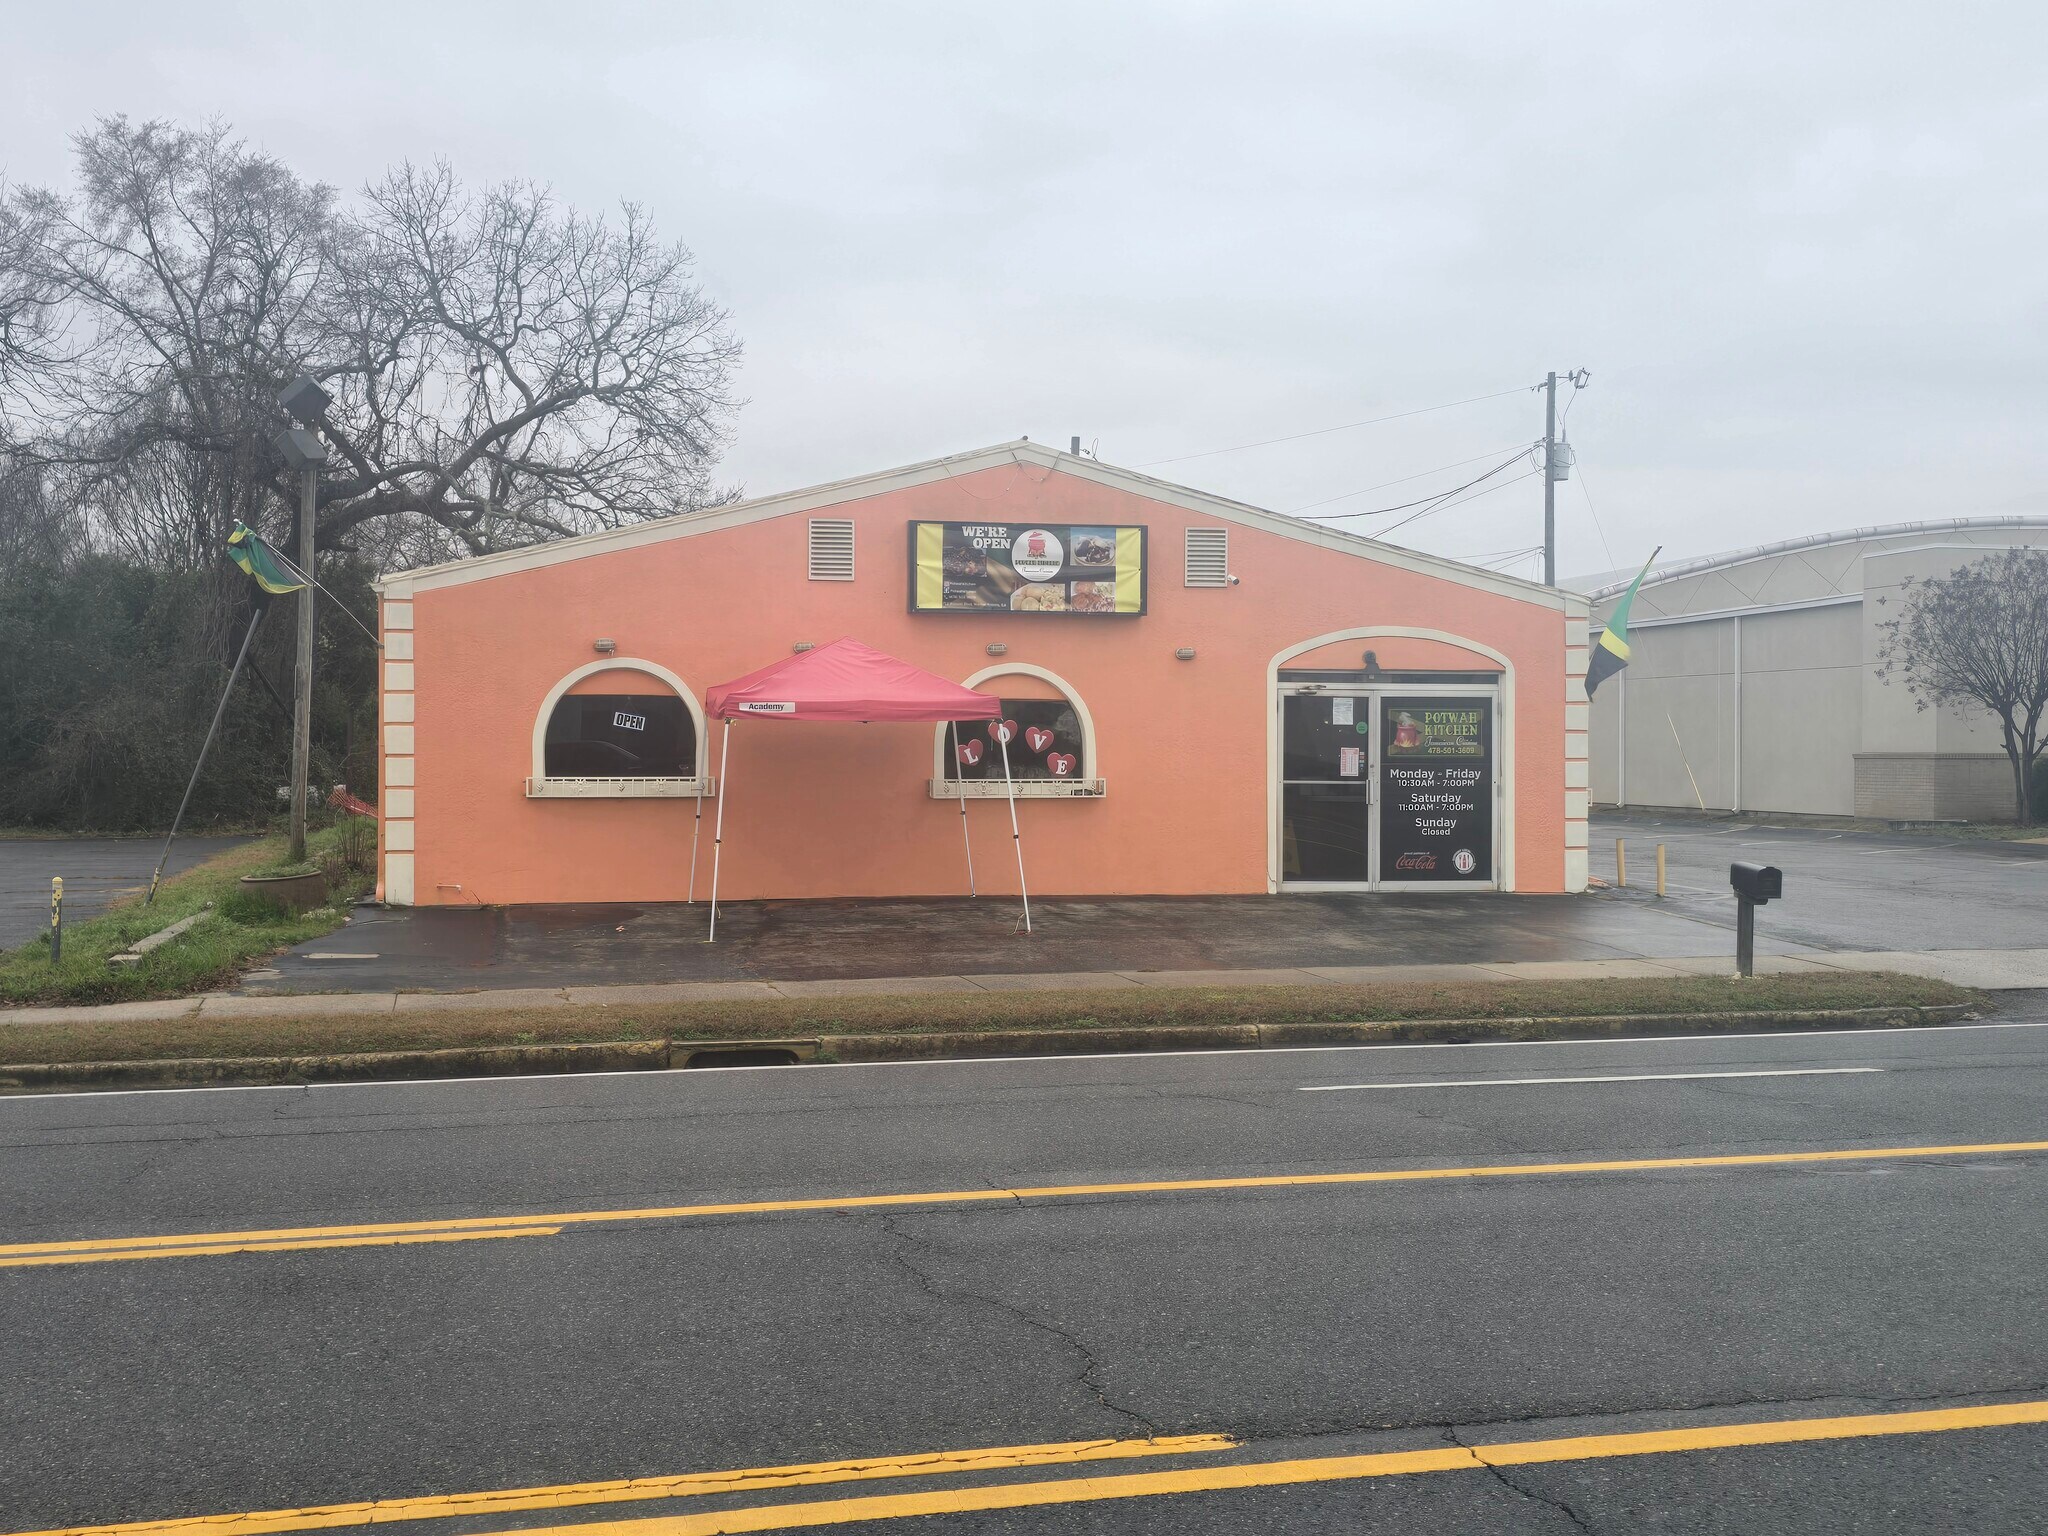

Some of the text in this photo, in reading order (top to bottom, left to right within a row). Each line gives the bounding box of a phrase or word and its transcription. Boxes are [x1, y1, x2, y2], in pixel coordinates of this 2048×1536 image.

[962, 526, 1007, 538] WE'RE
[972, 538, 1011, 549] OPEN
[748, 703, 785, 711] Academy
[616, 713, 644, 729] OPEN
[1424, 712, 1478, 723] POTWAH
[1424, 724, 1478, 735] KITCHEN
[1390, 768, 1435, 780] Monday
[1445, 768, 1482, 780] Friday
[1411, 793, 1462, 804] Saturday
[1415, 817, 1457, 829] Sunday
[1421, 828, 1451, 836] Closed
